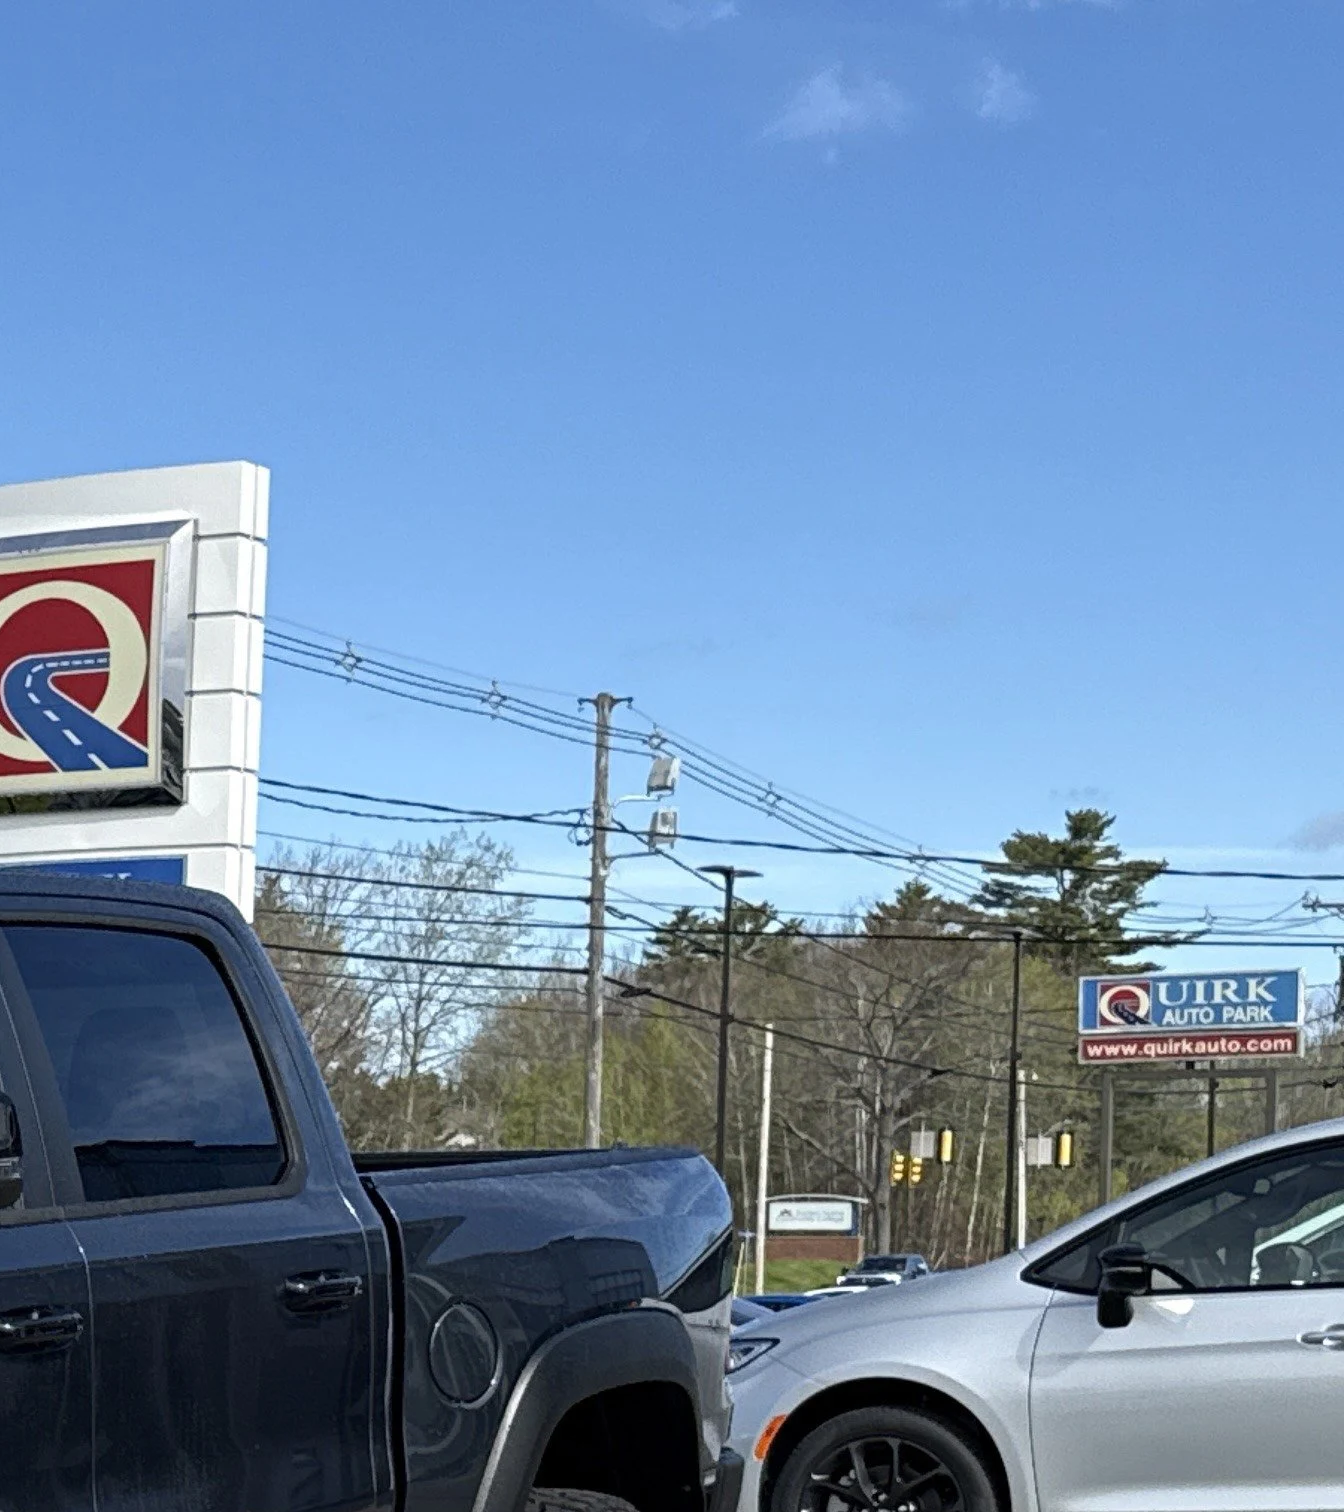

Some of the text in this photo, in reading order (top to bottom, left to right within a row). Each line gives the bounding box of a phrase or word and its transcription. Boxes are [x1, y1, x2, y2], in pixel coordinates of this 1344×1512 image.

[1162, 1005, 1274, 1026] AUTO PARK
[1086, 1036, 1293, 1058] www.quirkauto.com
